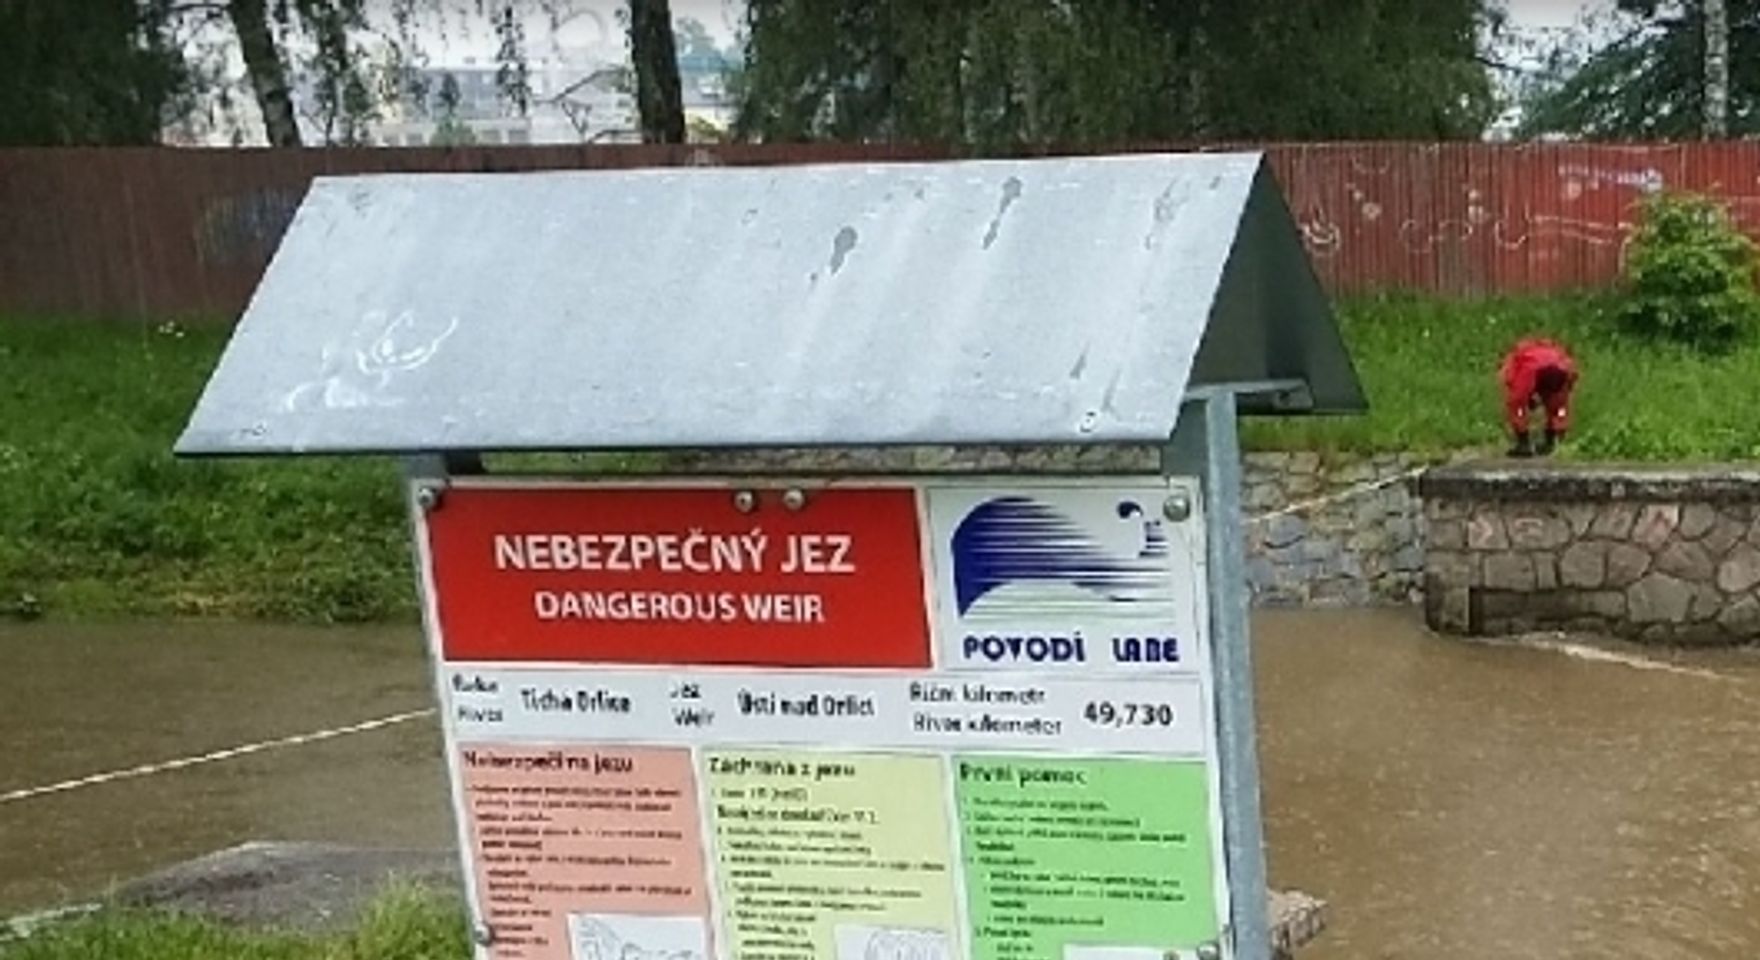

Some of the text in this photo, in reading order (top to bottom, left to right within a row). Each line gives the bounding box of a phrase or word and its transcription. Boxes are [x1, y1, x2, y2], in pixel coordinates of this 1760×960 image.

[494, 527, 855, 573] NEBEZPEČNÝ JEZ
[534, 590, 825, 623] DANGEROUS WEIR
[963, 632, 1086, 662] POVODÍ
[780, 693, 819, 716] nad
[963, 683, 1045, 706] kilometr
[671, 706, 715, 727] Weir
[968, 713, 1062, 736] kilometer
[1083, 701, 1174, 728] 49,730
[594, 753, 633, 775] jezu
[1019, 768, 1088, 788] pomoc
